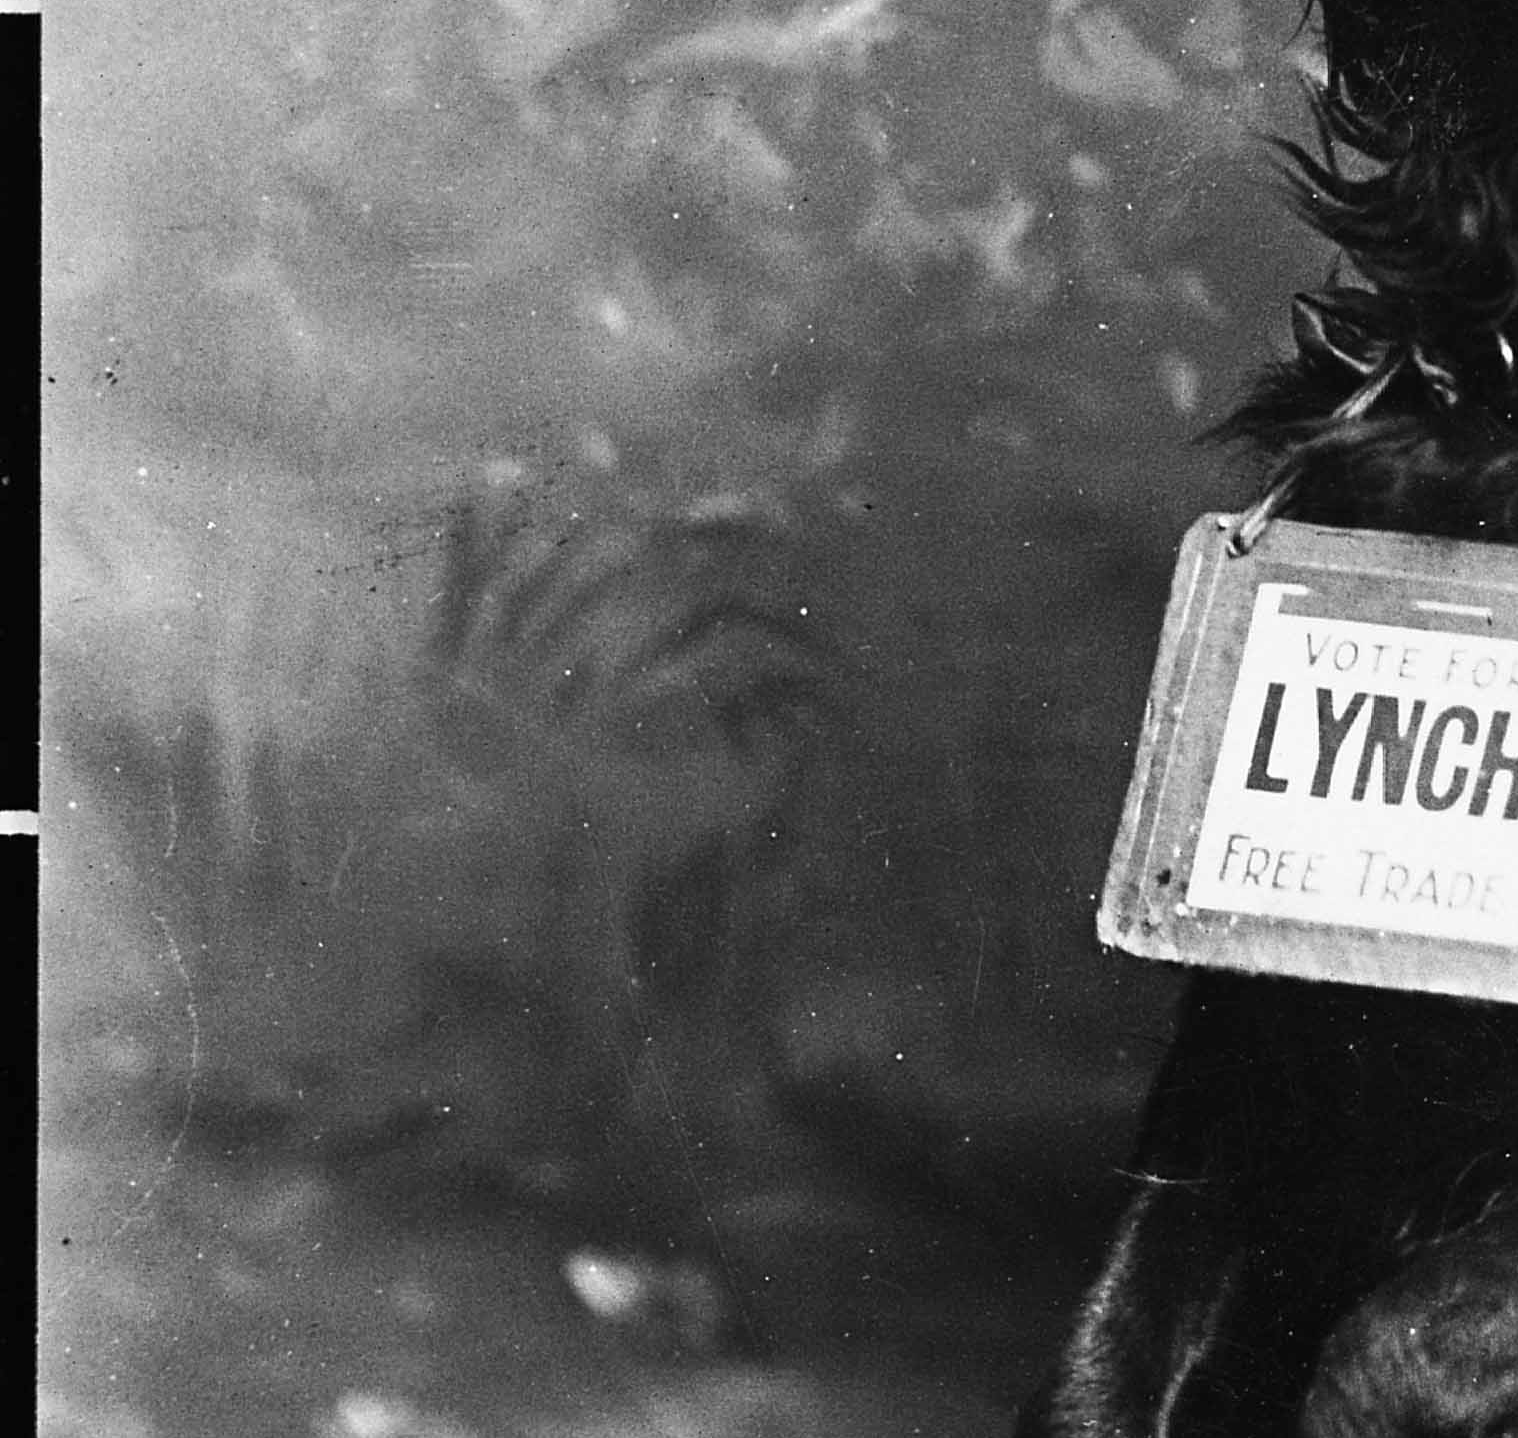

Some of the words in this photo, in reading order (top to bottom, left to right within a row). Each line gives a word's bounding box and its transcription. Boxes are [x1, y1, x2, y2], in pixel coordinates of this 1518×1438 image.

[1305, 631, 1420, 680] VOTE
[1218, 832, 1328, 896] FREE
[1358, 848, 1506, 916] TRADE
